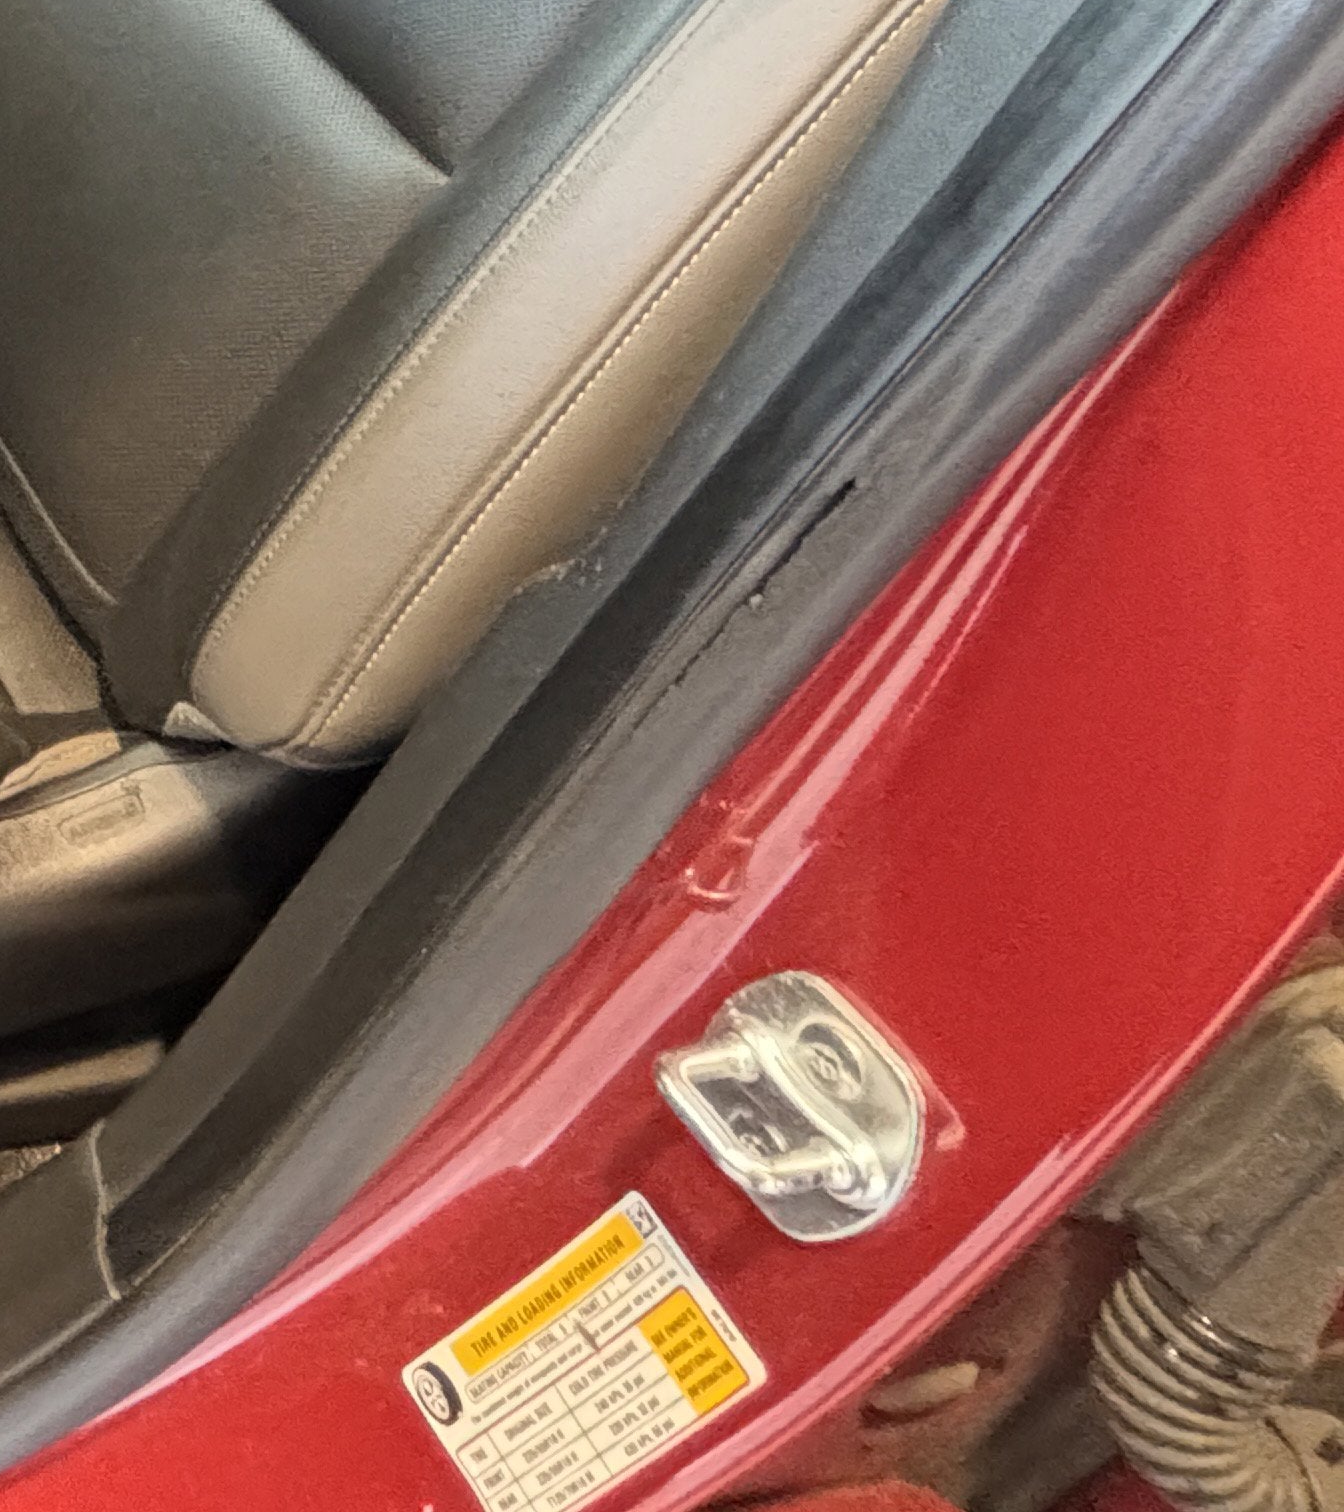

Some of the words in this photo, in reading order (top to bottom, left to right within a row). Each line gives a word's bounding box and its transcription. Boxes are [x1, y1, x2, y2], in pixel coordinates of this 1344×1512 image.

[470, 1331, 497, 1357] TIRE
[495, 1316, 519, 1341] AND
[516, 1283, 562, 1325] LOADING
[558, 1234, 625, 1292] INFORMATION
